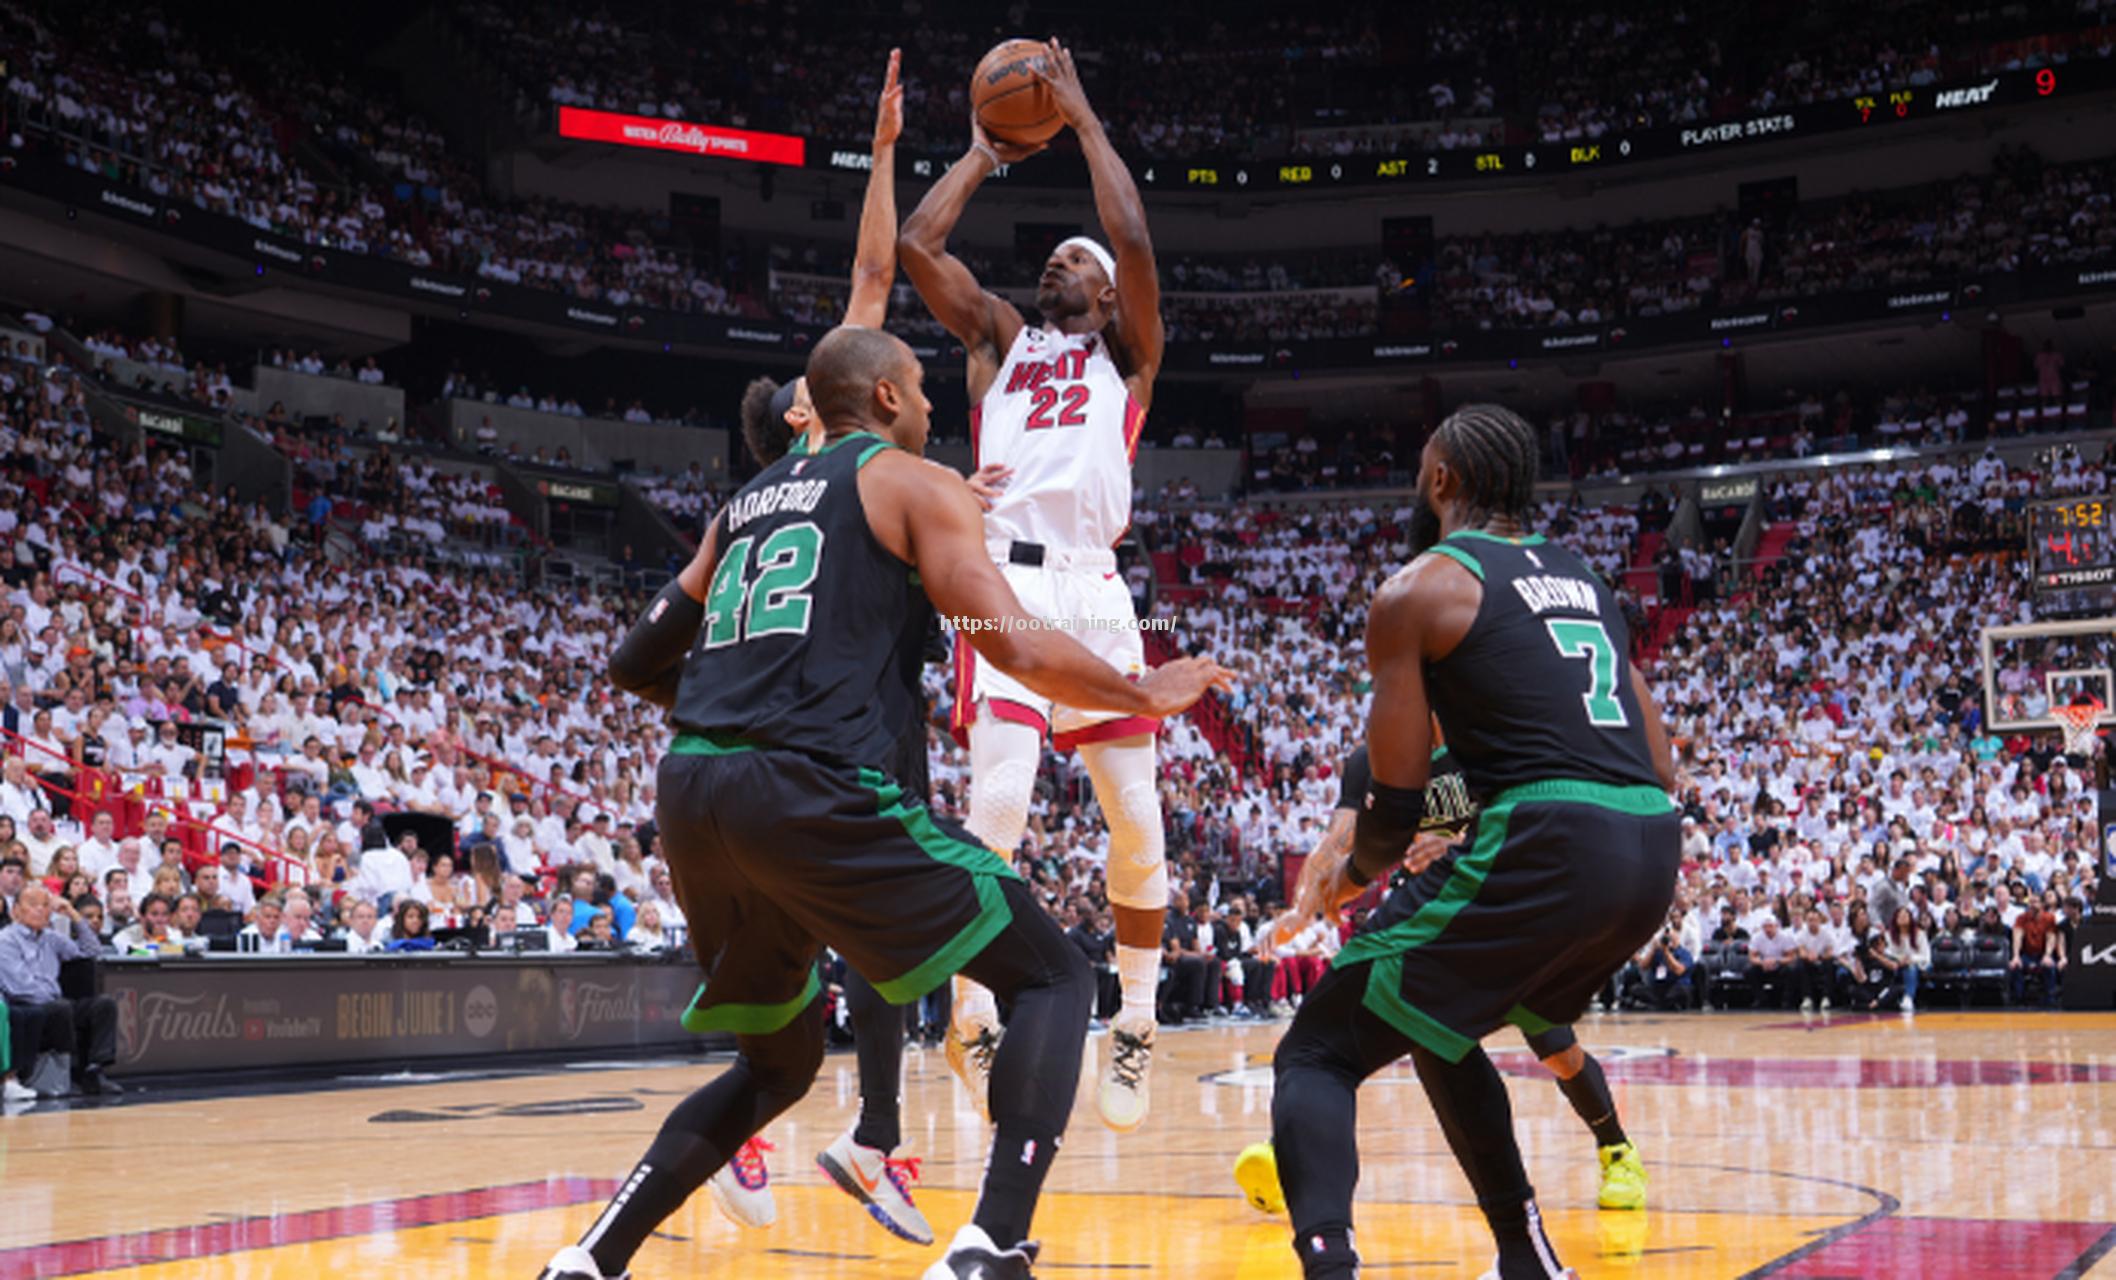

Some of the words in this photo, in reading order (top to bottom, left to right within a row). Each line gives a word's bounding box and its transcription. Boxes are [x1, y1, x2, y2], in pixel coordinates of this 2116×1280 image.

[1936, 79, 1998, 108] HEAT
[2036, 69, 2056, 95] 9
[659, 123, 708, 152] Bally
[1682, 123, 1742, 146] PLAYER
[1746, 115, 1795, 135] STATS
[831, 152, 873, 169] HEA
[1145, 169, 1154, 182] 4
[1188, 169, 1218, 184] PTS
[1237, 171, 1248, 184] 0
[1279, 166, 1312, 182] REB
[1331, 164, 1342, 179] 0
[1377, 161, 1407, 176] AST
[1428, 159, 1438, 175] 2
[1475, 155, 1504, 171] STL
[1571, 147, 1600, 163] BLK
[1620, 140, 1630, 155] 0
[1004, 345, 1094, 394] HEAT
[1025, 384, 1090, 431] 22
[729, 479, 827, 532] HORFORD
[2056, 502, 2103, 528] 7:52
[703, 521, 824, 650] 42
[1512, 575, 1599, 617] BROWN
[2058, 568, 2115, 585] TISSOT
[1544, 619, 1629, 727] 7
[128, 991, 240, 1063] Finals
[337, 993, 393, 1040] BEGIN
[397, 992, 444, 1036] JUNE
[446, 991, 455, 1034] 1
